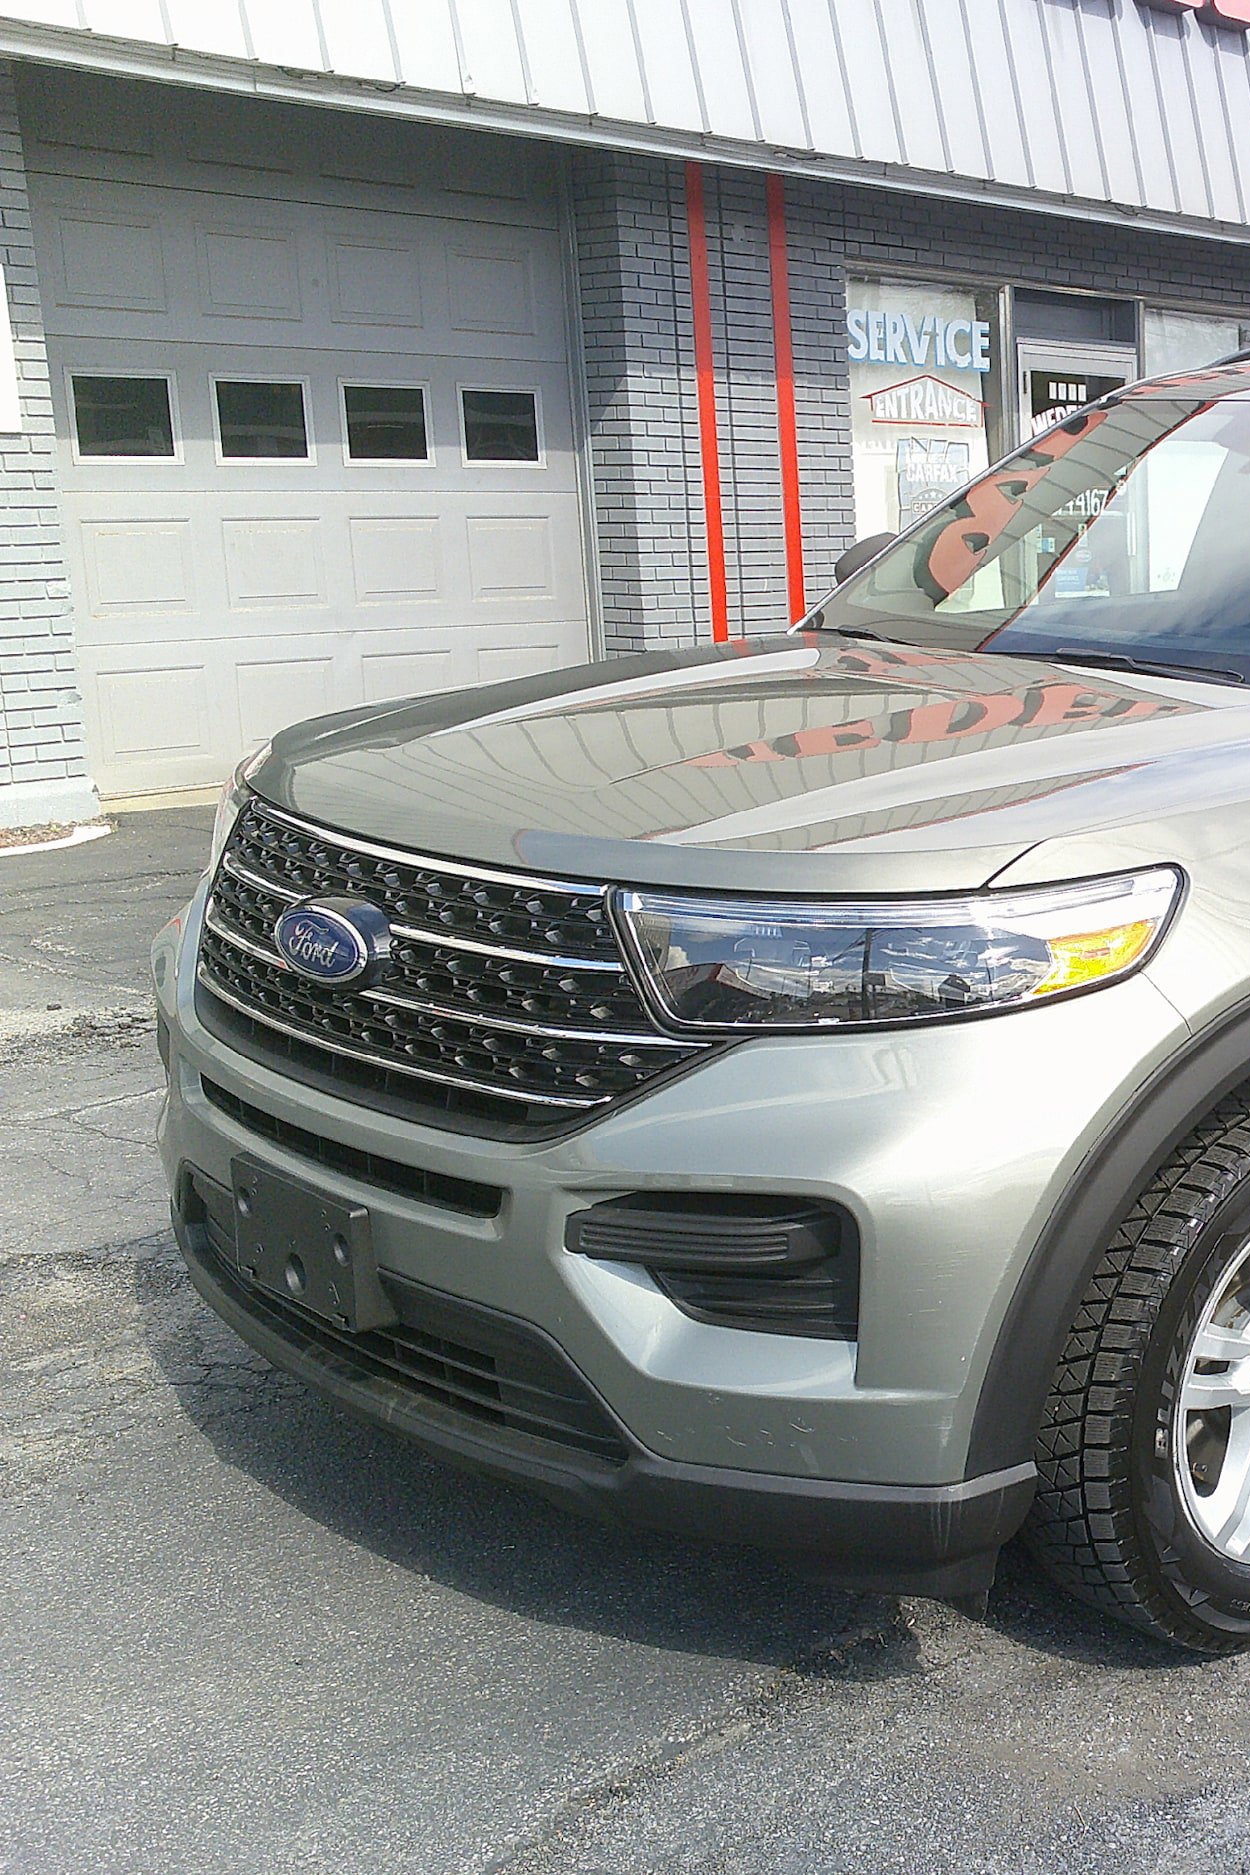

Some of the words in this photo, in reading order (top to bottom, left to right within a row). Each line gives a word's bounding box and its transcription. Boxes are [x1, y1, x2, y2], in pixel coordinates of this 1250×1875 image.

[847, 309, 990, 372] SERVICE
[875, 381, 977, 422] ENTRANCE
[906, 463, 959, 483] CARFAX
[288, 919, 340, 968] Ford
